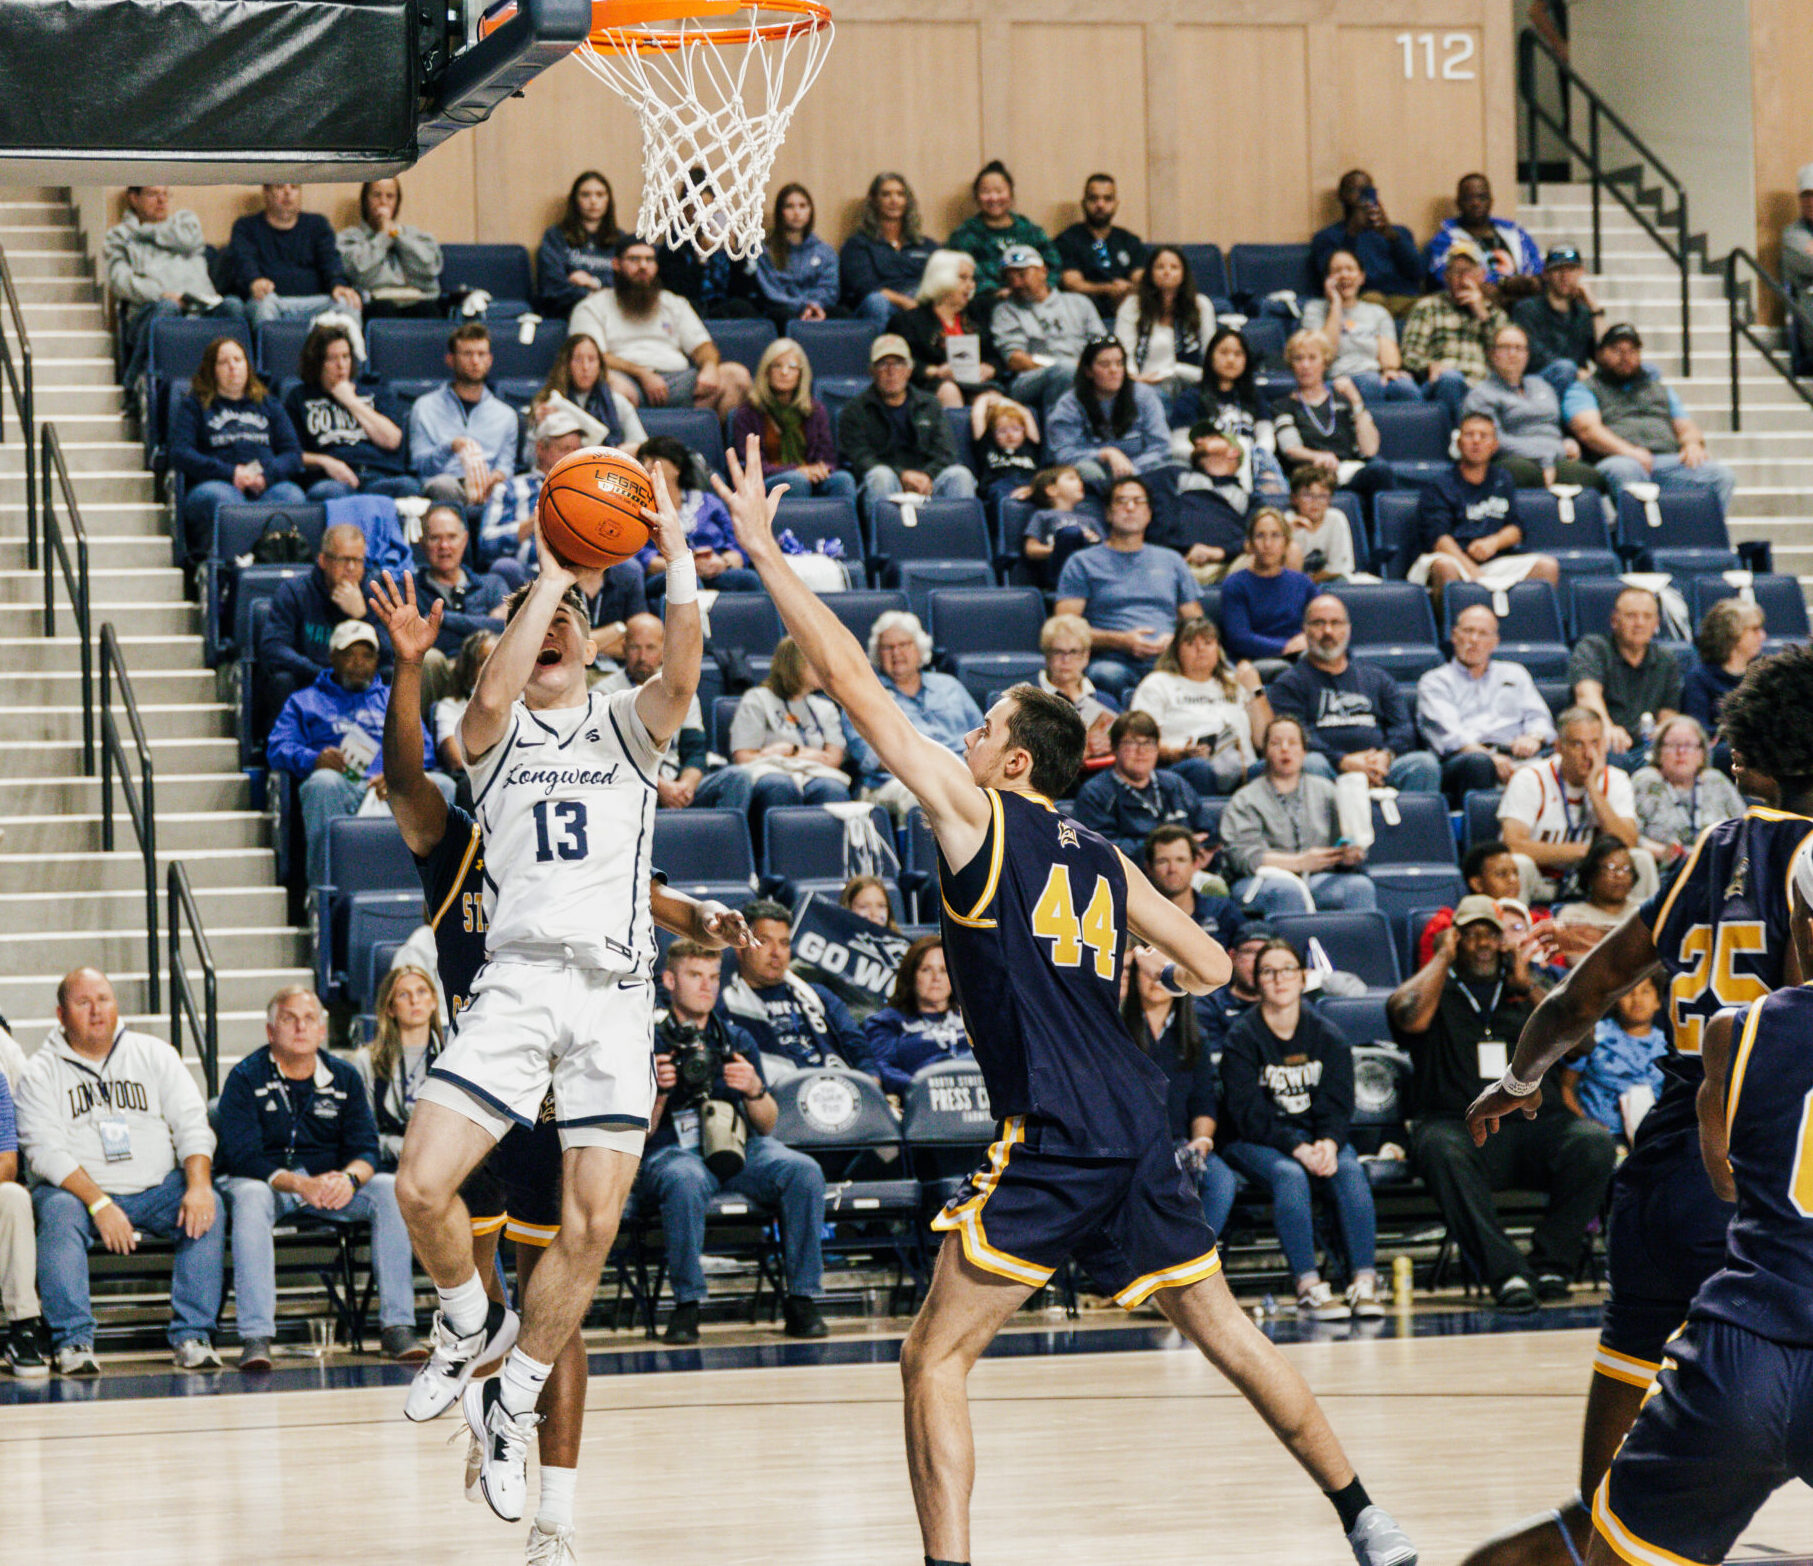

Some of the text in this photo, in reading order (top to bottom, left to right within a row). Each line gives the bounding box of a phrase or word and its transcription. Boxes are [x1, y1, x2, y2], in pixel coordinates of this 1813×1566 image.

[1395, 32, 1475, 79] 112
[594, 469, 655, 503] LEGACY
[503, 763, 619, 796] Longwood
[532, 800, 589, 862] 13
[462, 891, 490, 933] ST
[1031, 862, 1119, 981] 44
[797, 930, 850, 975] GO
[1669, 920, 1773, 1056] 25
[929, 1087, 972, 1112] PRESS
